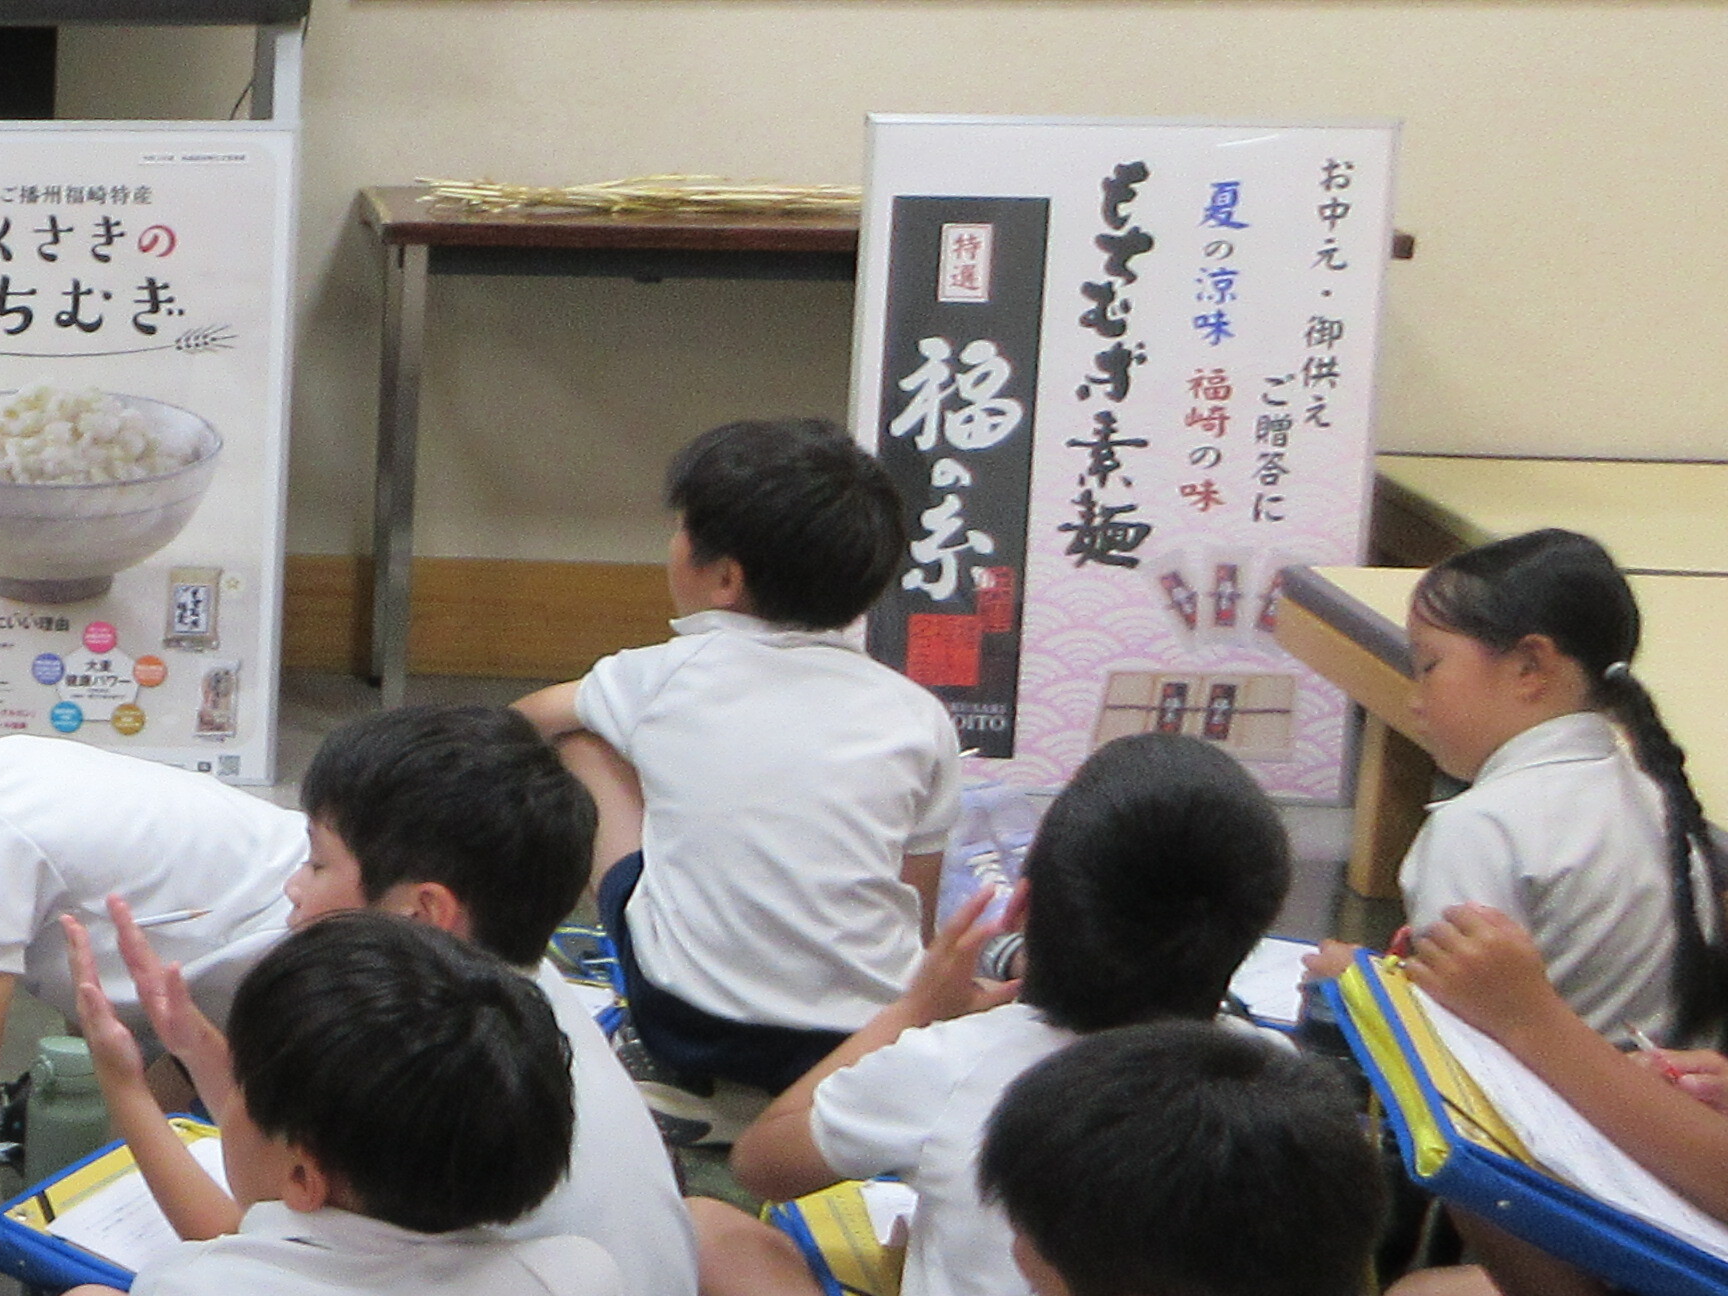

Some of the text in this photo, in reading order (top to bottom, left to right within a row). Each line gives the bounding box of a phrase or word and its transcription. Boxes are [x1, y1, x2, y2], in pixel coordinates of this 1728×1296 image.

[946, 232, 981, 292] 特選
[1056, 161, 1156, 570] もちむぎ素麺
[1179, 181, 1250, 513] 夏の涼味 福崎の味
[1300, 158, 1356, 430] お中元・御供え
[889, 336, 1024, 601] 福の糸
[1250, 374, 1296, 524] ご贈答に
